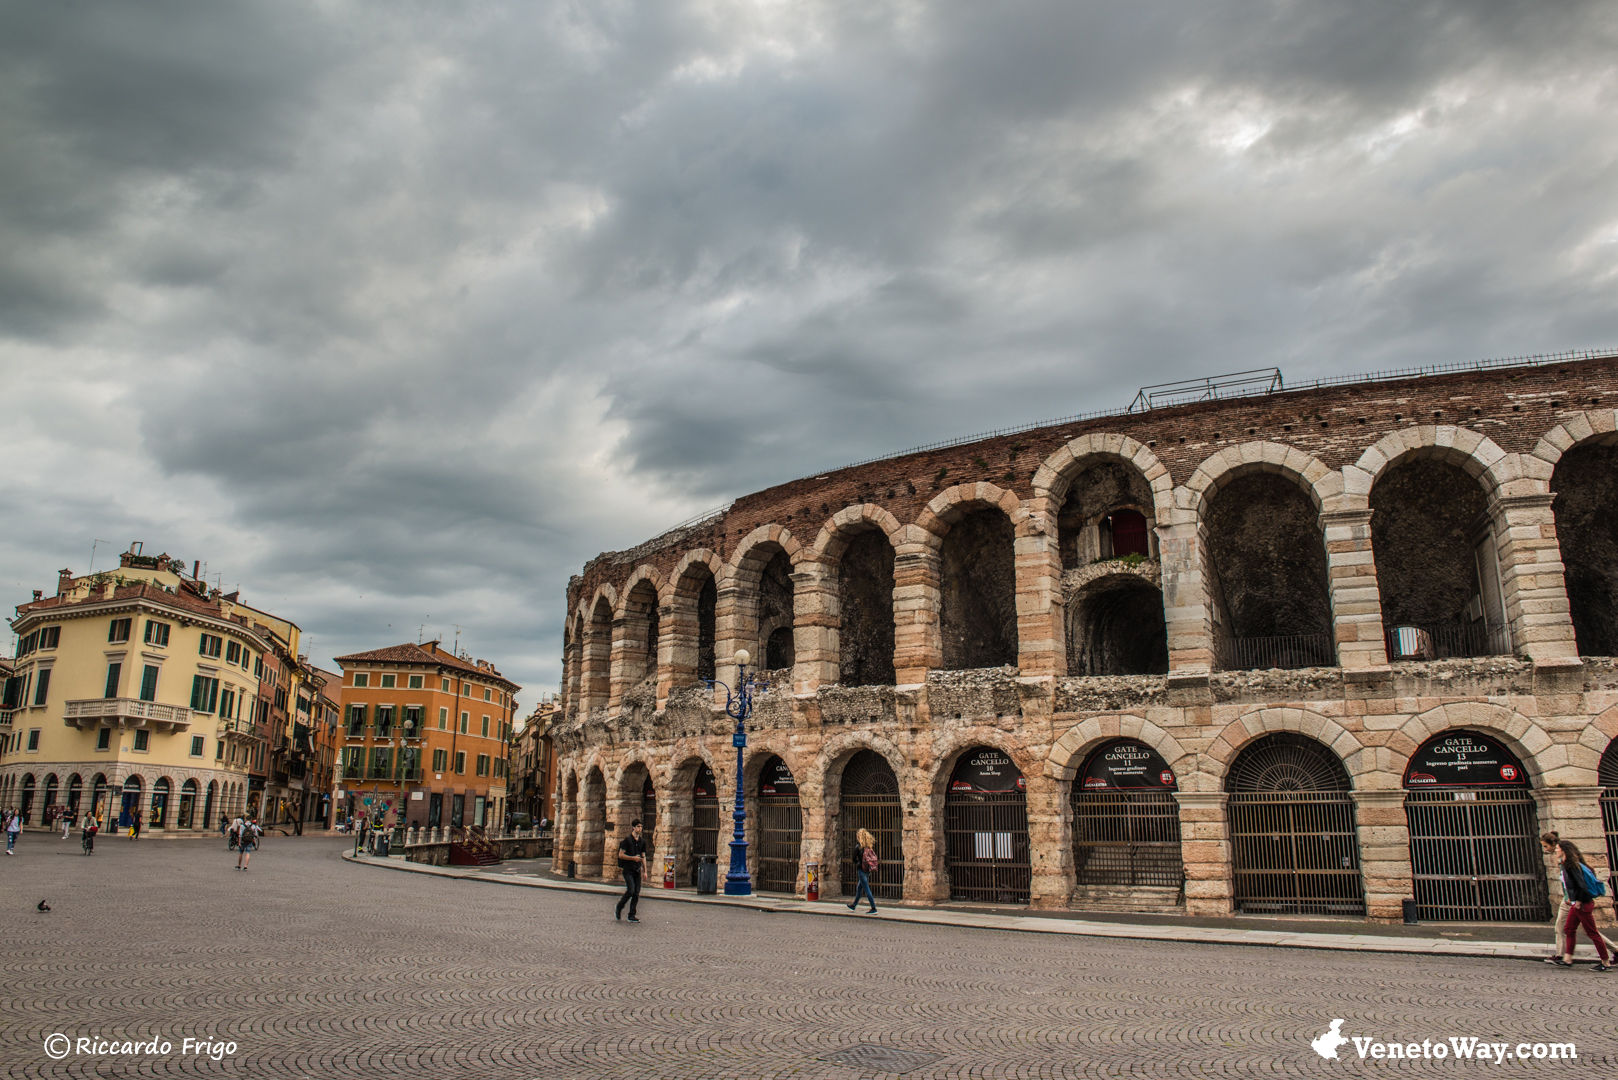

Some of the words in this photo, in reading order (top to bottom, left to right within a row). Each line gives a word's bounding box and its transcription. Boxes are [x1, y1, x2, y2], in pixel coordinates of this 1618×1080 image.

[1445, 738, 1472, 746] GATE
[1434, 745, 1487, 753] CANCELLO
[1457, 753, 1467, 761] 13
